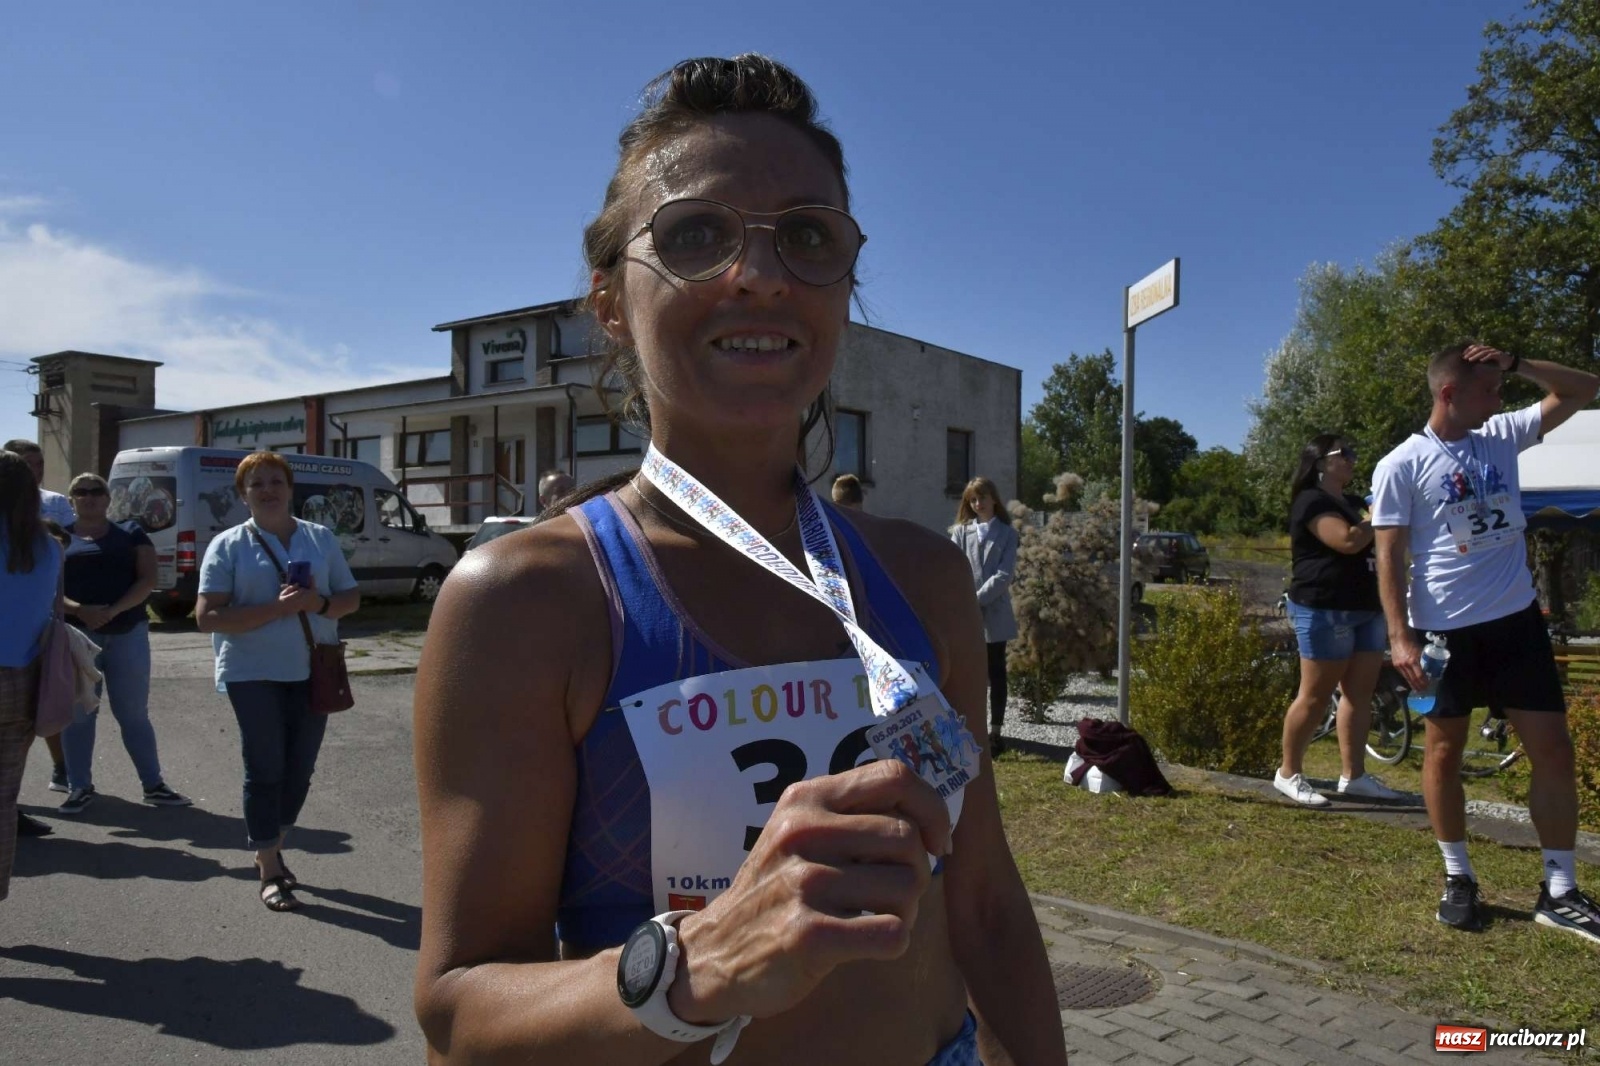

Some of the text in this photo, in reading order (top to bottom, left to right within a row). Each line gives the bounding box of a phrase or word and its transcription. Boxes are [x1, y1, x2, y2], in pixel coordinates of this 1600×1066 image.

[288, 462, 353, 476] OMIAR CZASU
[1468, 509, 1510, 535] 32
[657, 679, 838, 735] COLOUR
[872, 709, 923, 744] 05.09.2021
[946, 768, 970, 792] RUN
[667, 875, 731, 890] 10km
